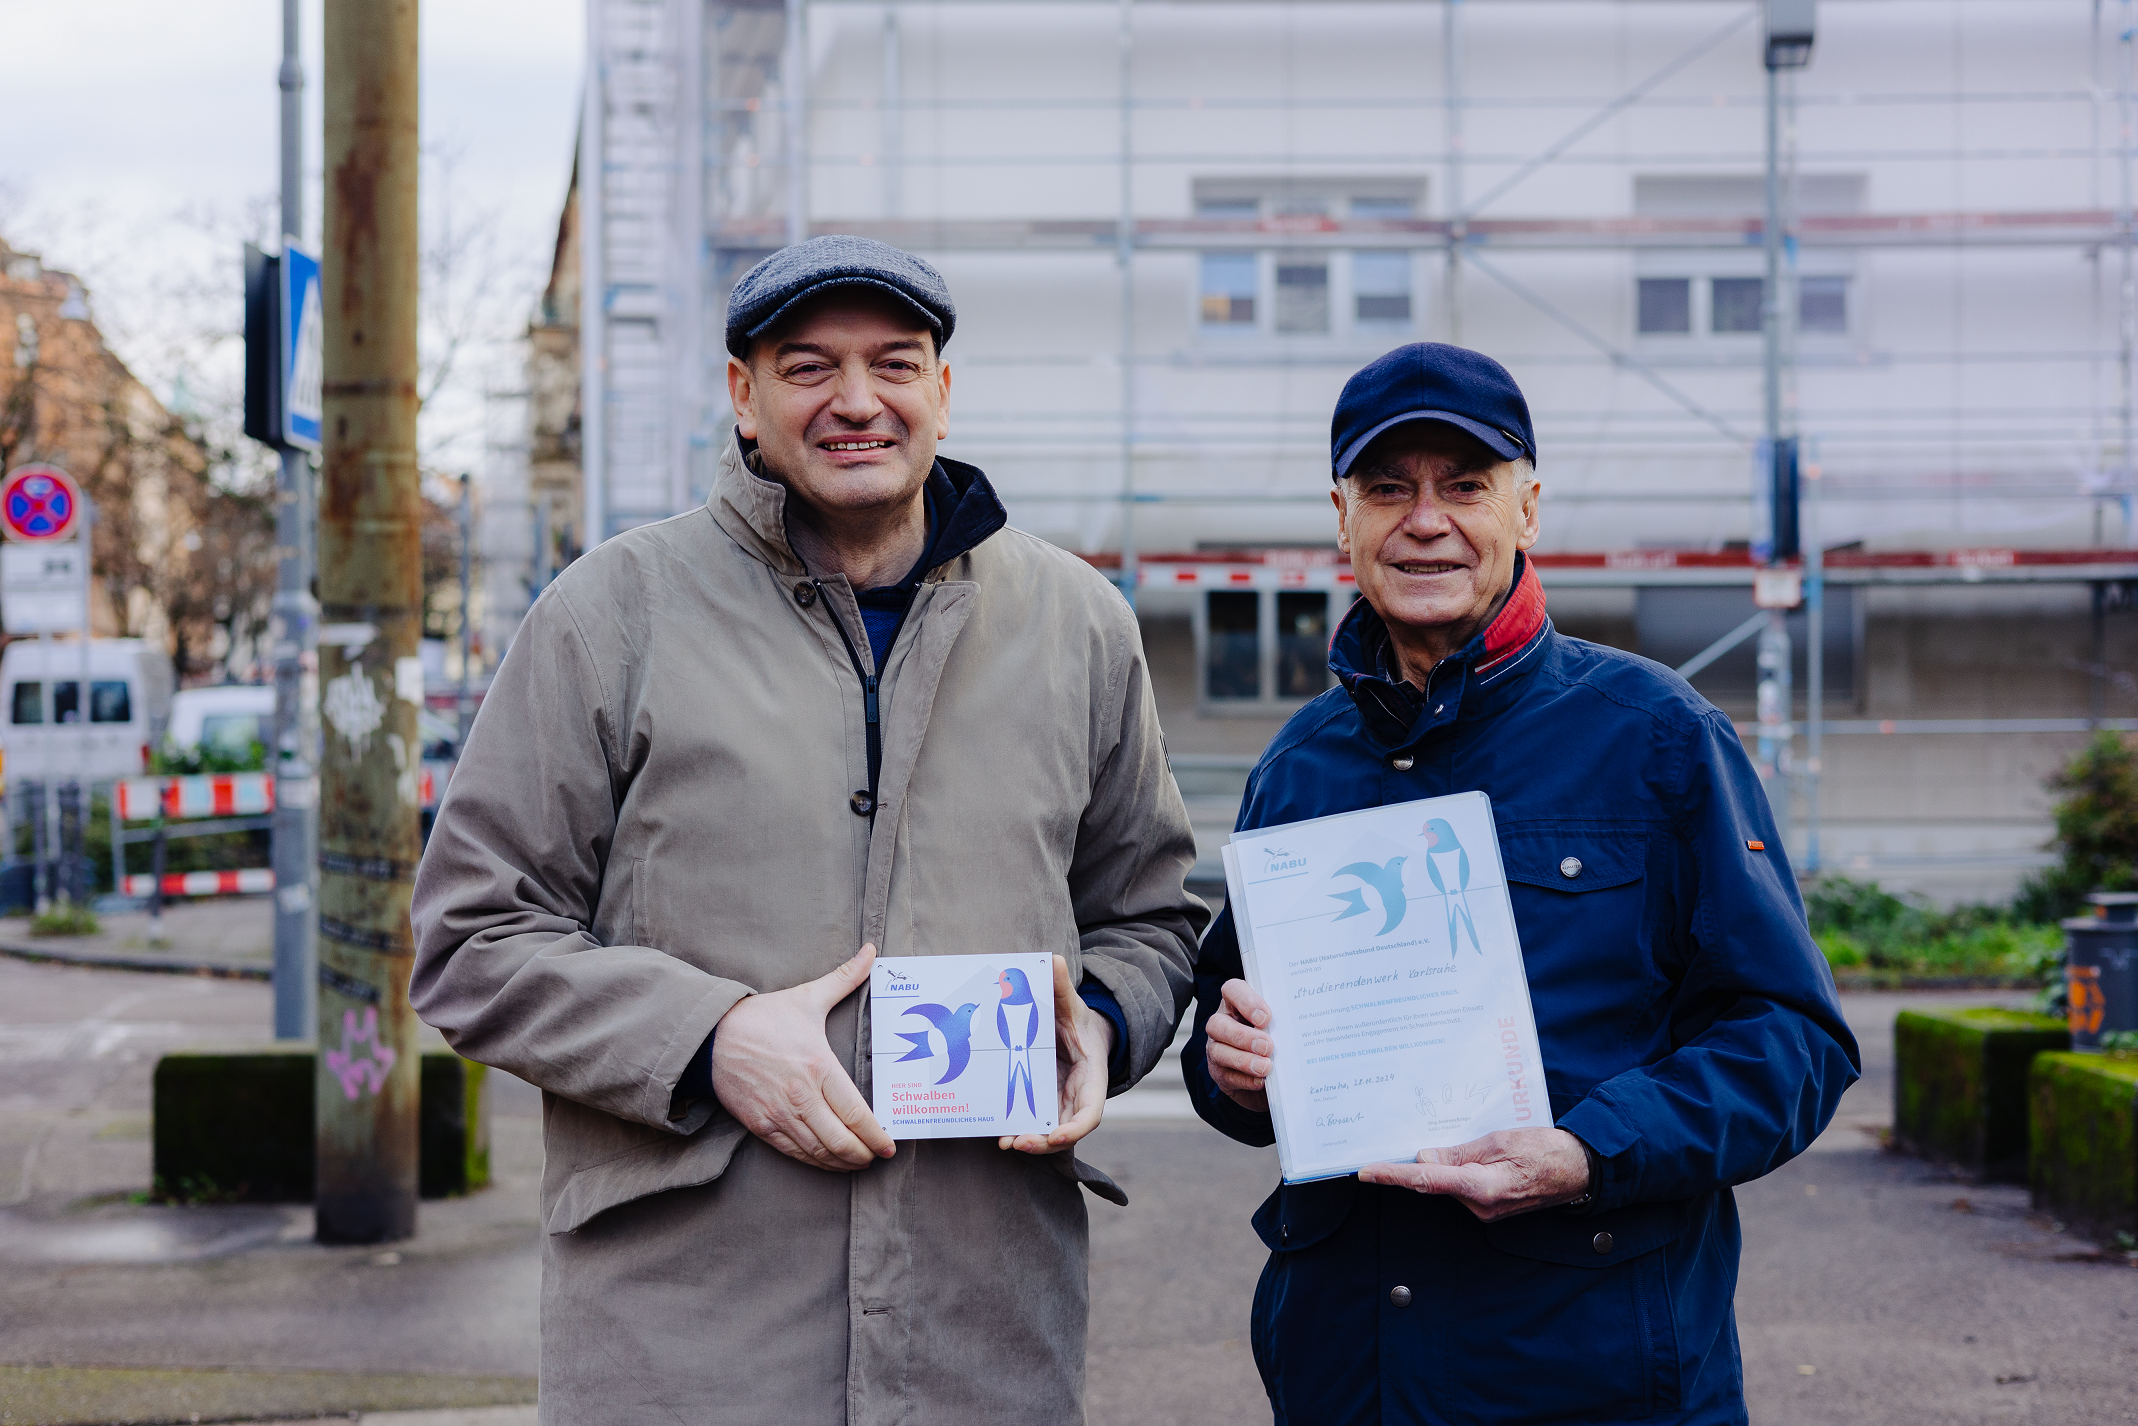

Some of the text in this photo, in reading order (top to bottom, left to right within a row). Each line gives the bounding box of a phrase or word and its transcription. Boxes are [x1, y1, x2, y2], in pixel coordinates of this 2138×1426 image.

[1270, 857, 1307, 872] NABU
[1300, 957, 1318, 966] NABU
[1375, 940, 1417, 952] Deutschland)
[1290, 968, 1313, 976] verleiht
[1293, 969, 1399, 1000] Studierendenwerk
[890, 983, 920, 991] NABU
[1309, 1006, 1351, 1019] Auszeichnung
[1350, 991, 1440, 1011] SCHWALBENFREUNDLICHES
[1439, 988, 1461, 997] HAUS.
[1312, 1027, 1336, 1036] danken
[1403, 1014, 1412, 1022] für
[1412, 1012, 1429, 1020] Ihren
[1429, 1007, 1462, 1017] wertvollen
[1462, 1004, 1485, 1013] Einsatz
[1325, 1032, 1361, 1043] besonderes
[1361, 1025, 1400, 1038] Engagement
[1408, 1016, 1463, 1030] Schwalbenschutz.
[1318, 1054, 1340, 1063] IHNEN
[1340, 1051, 1357, 1059] SIND
[1357, 1044, 1399, 1056] SCHWALBEN
[1398, 1037, 1447, 1050] WILLKOMMEN!
[1498, 1016, 1533, 1122] URKUNDE
[892, 1090, 956, 1102] Schwalben
[892, 1103, 970, 1115] willkommen!
[892, 1116, 977, 1126] SCHWALBENFREUNDLICHES
